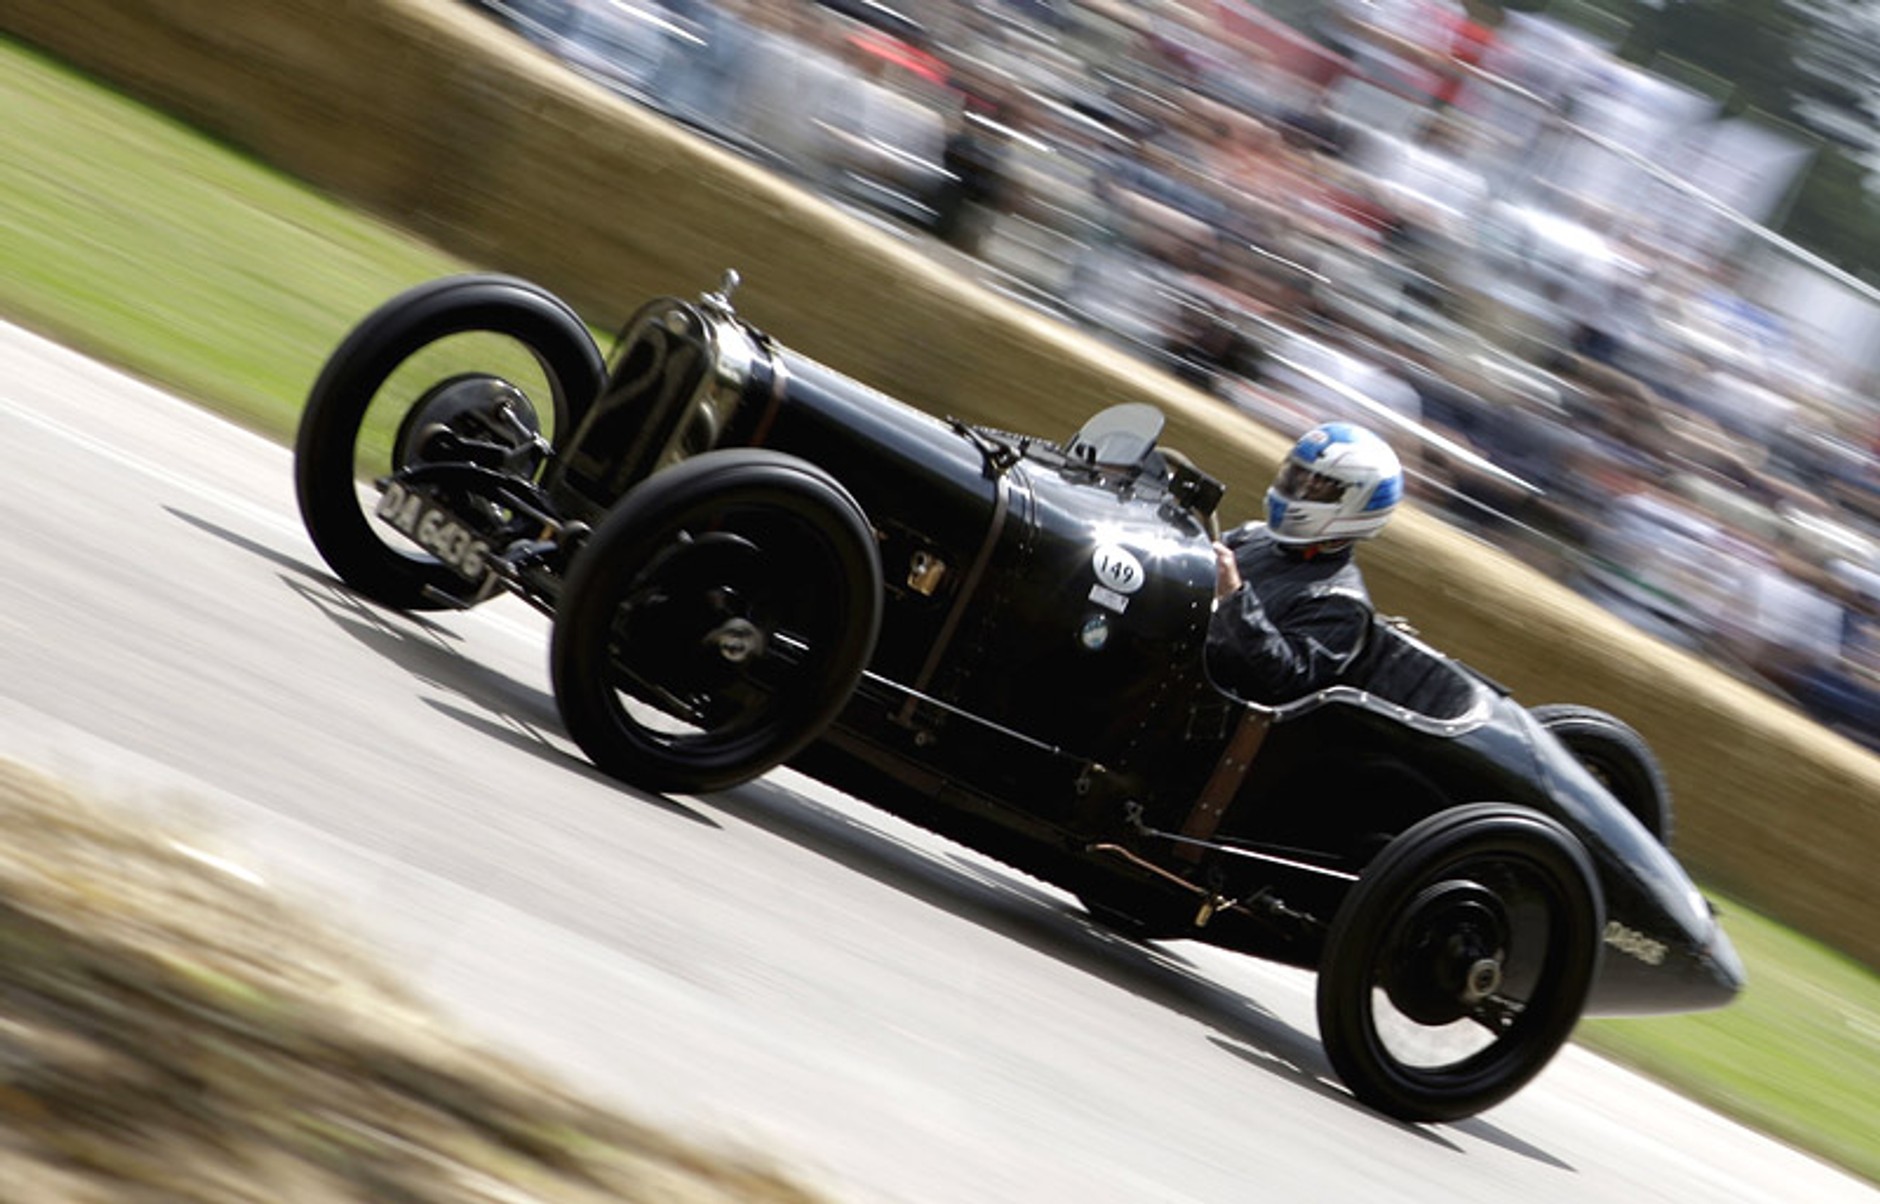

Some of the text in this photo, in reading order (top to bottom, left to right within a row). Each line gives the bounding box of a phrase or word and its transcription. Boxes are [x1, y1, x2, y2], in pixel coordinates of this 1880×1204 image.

[377, 481, 490, 577] DA 6436
[1102, 555, 1134, 584] 149
